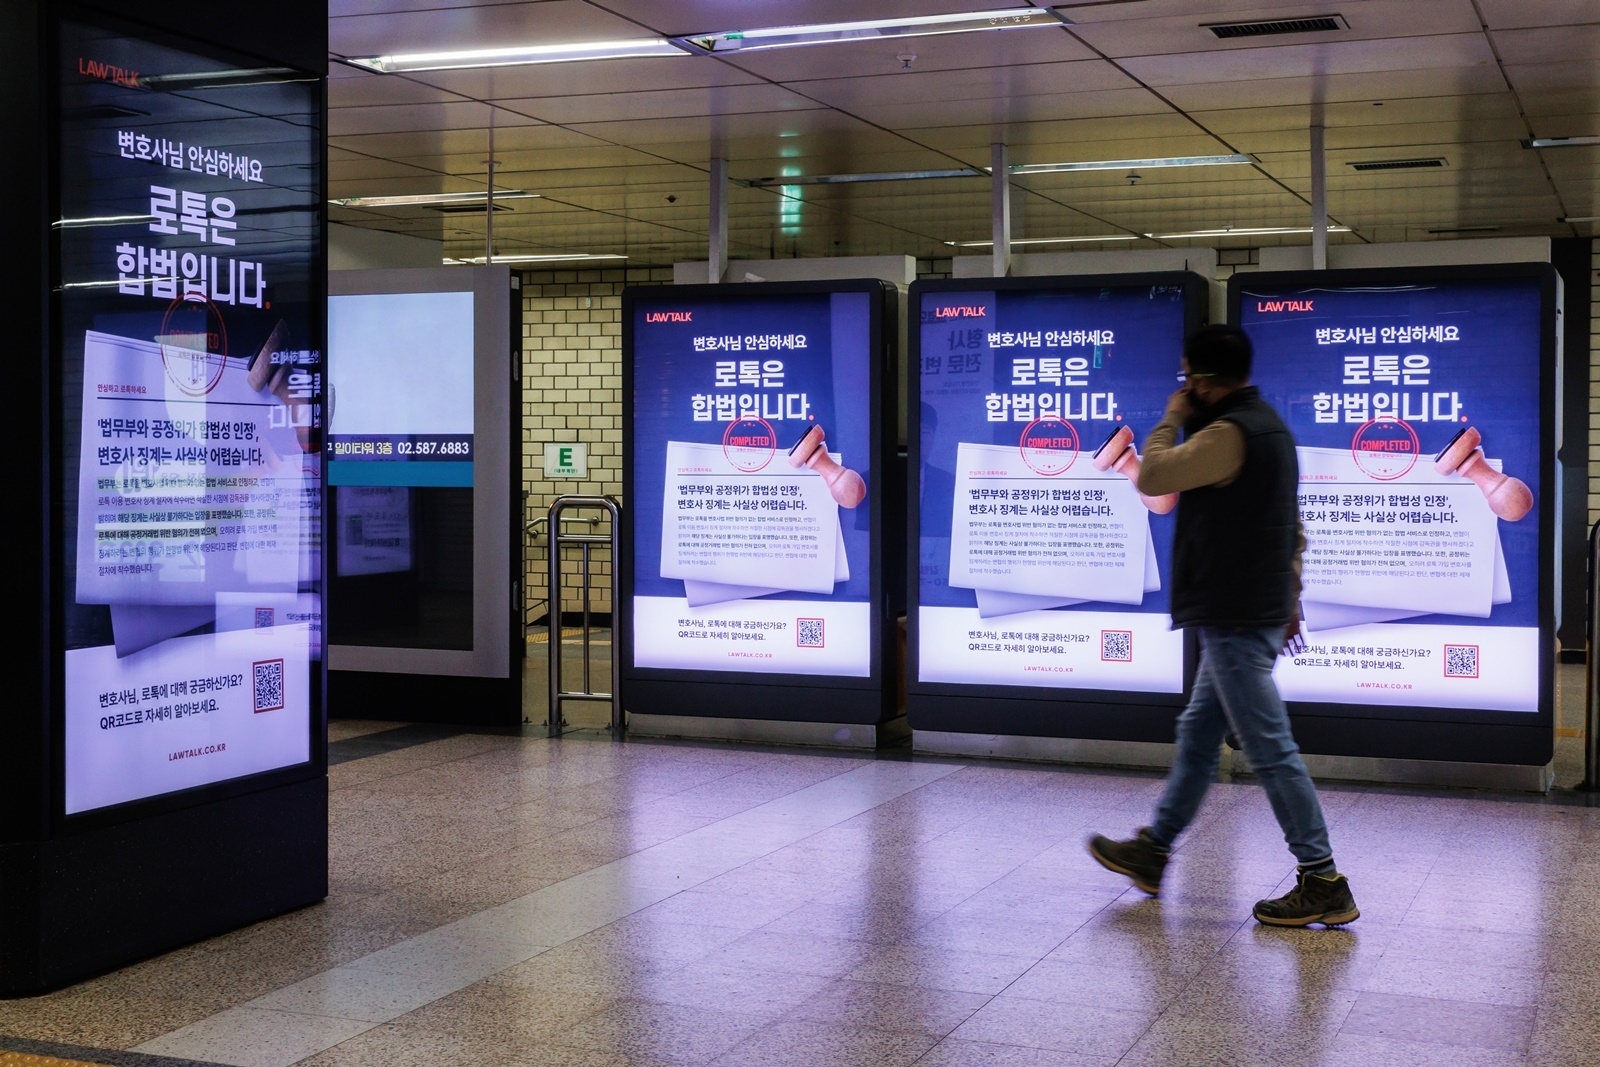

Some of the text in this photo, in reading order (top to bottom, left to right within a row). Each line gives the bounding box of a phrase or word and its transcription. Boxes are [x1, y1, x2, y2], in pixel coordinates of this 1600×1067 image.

[78, 57, 139, 88] LAWTALK
[118, 130, 263, 182] 변호사님 안심하세요
[148, 185, 237, 245] 로톡은
[115, 242, 270, 309] 합법입니다.
[935, 306, 985, 317] LAWTALK
[1257, 300, 1313, 312] LAWTALK
[646, 312, 691, 322] LAWTALK
[987, 329, 1114, 347] 변호사님 안심하세요
[1315, 325, 1459, 344] 변호사님 안심하세요
[693, 334, 807, 351] 변호사님 안심하세요
[715, 360, 784, 388] 로톡은
[1011, 357, 1088, 386] 로톡은
[1342, 354, 1430, 385] 로톡은
[691, 392, 814, 421] 합법입니다.
[985, 391, 1121, 421] 합법입니다.
[1313, 391, 1467, 423] 합법입니다.
[97, 416, 258, 442] '법무부와 공정위가 합법성 인정',
[729, 436, 769, 445] COMPLETED
[1027, 437, 1071, 447] COMPLETED
[1361, 440, 1410, 450] COMPLETED
[97, 444, 264, 467] 변호사 징계는 사실상 어렵습니다.
[335, 442, 375, 455] 일이타워
[376, 442, 393, 455] 3층
[397, 442, 469, 454] 02.587.6883
[559, 447, 573, 467] E
[677, 484, 802, 496] '법무부와 공정위가 합법성 인정',
[968, 488, 1108, 501] '법무부와 공정위가 합법성 인정',
[677, 499, 807, 510] 변호사 징계는 사실상 어렵습니다.
[1342, 494, 1385, 507] 공정위가
[1388, 494, 1420, 507] 합법성
[1423, 495, 1451, 507] 인정',
[968, 503, 1113, 516] 변호사 징계는 사실상 어렵습니다.
[1329, 510, 1361, 522] 징계는
[1364, 511, 1396, 522] 사실상
[1399, 511, 1458, 523] 어렵습니다.
[678, 618, 786, 630] 변호사님, 로톡에 대해 궁금하신가요?
[678, 630, 766, 640] QR코드로 자세히 알아보세요.
[968, 630, 1089, 643] 변호사님, 로톡에 대해 궁금하신가요?
[968, 642, 1066, 654] QR코드로 자세히 알아보세요.
[1331, 645, 1355, 656] 로톡에
[1357, 646, 1373, 656] 대해
[1375, 647, 1430, 658] 궁금하신가요?
[1293, 657, 1404, 669] QR코드로 자세히 알아보세요.
[99, 672, 242, 709] 변호사님, 로톡에 대해 궁금하신가요?
[100, 697, 219, 731] QR코드로 자세히 알아보세요.
[168, 743, 225, 761] LAWTALK.CO.KR
